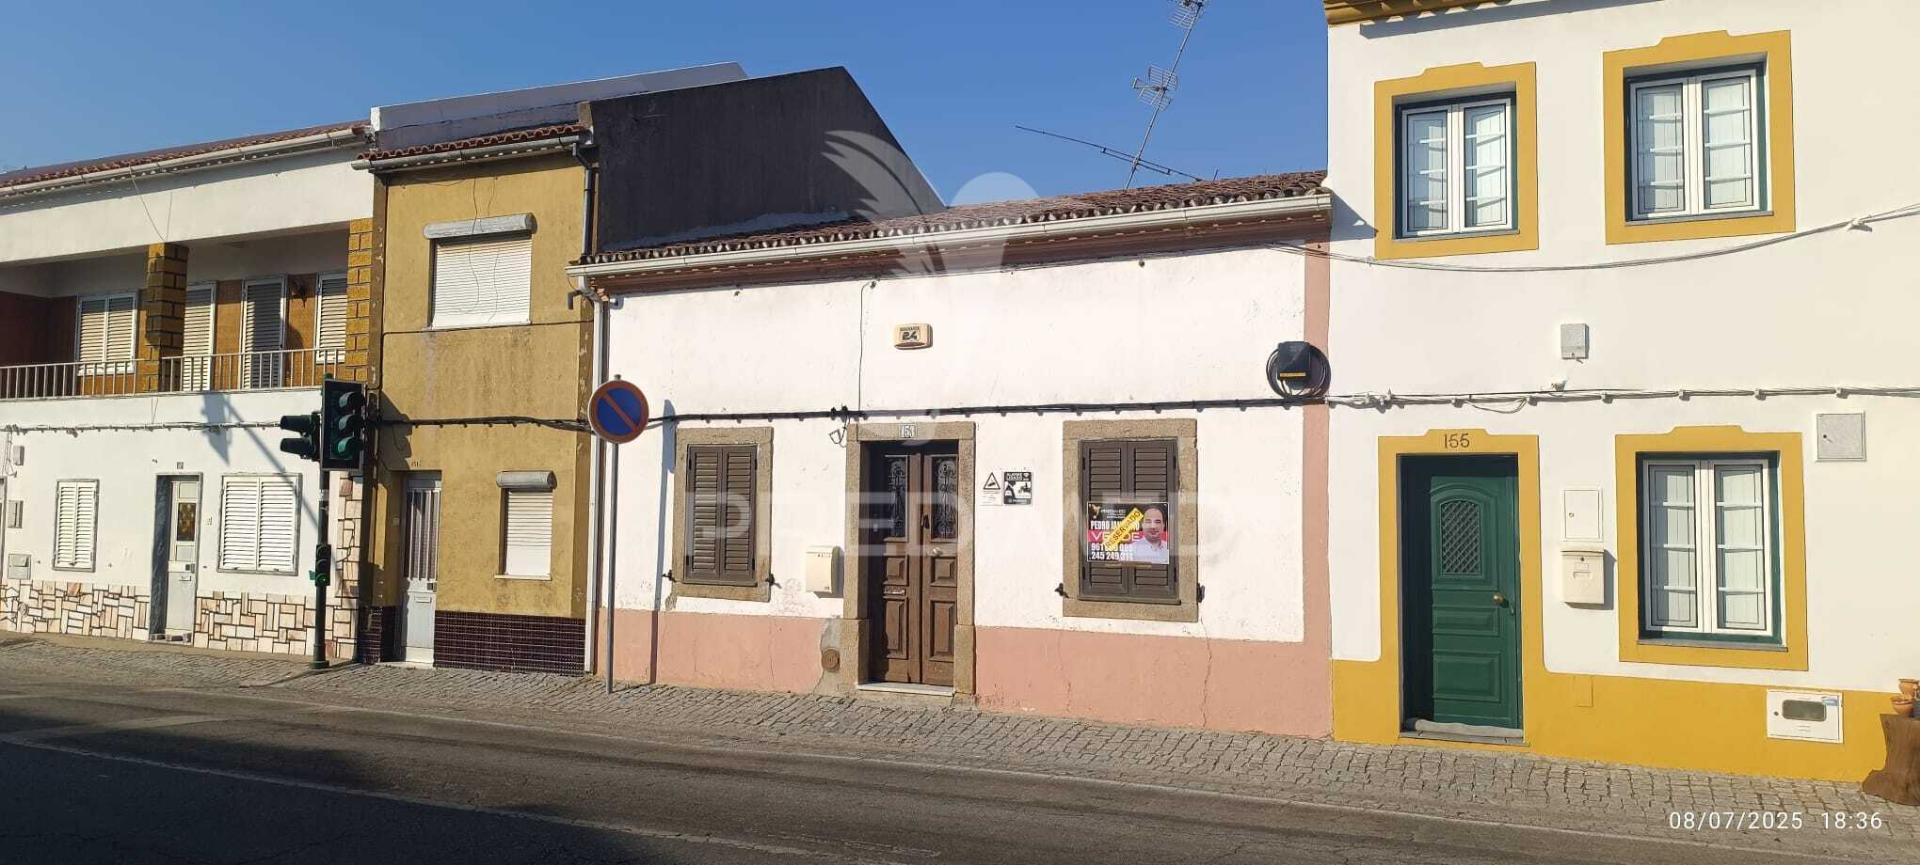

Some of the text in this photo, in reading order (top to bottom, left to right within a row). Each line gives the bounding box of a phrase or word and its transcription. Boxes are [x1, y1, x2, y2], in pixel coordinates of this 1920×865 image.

[902, 331, 917, 340] 24
[1444, 433, 1470, 449] 155
[1090, 520, 1110, 530] PEDRO
[1091, 531, 1140, 542] VEDE
[1091, 551, 1105, 560] 245
